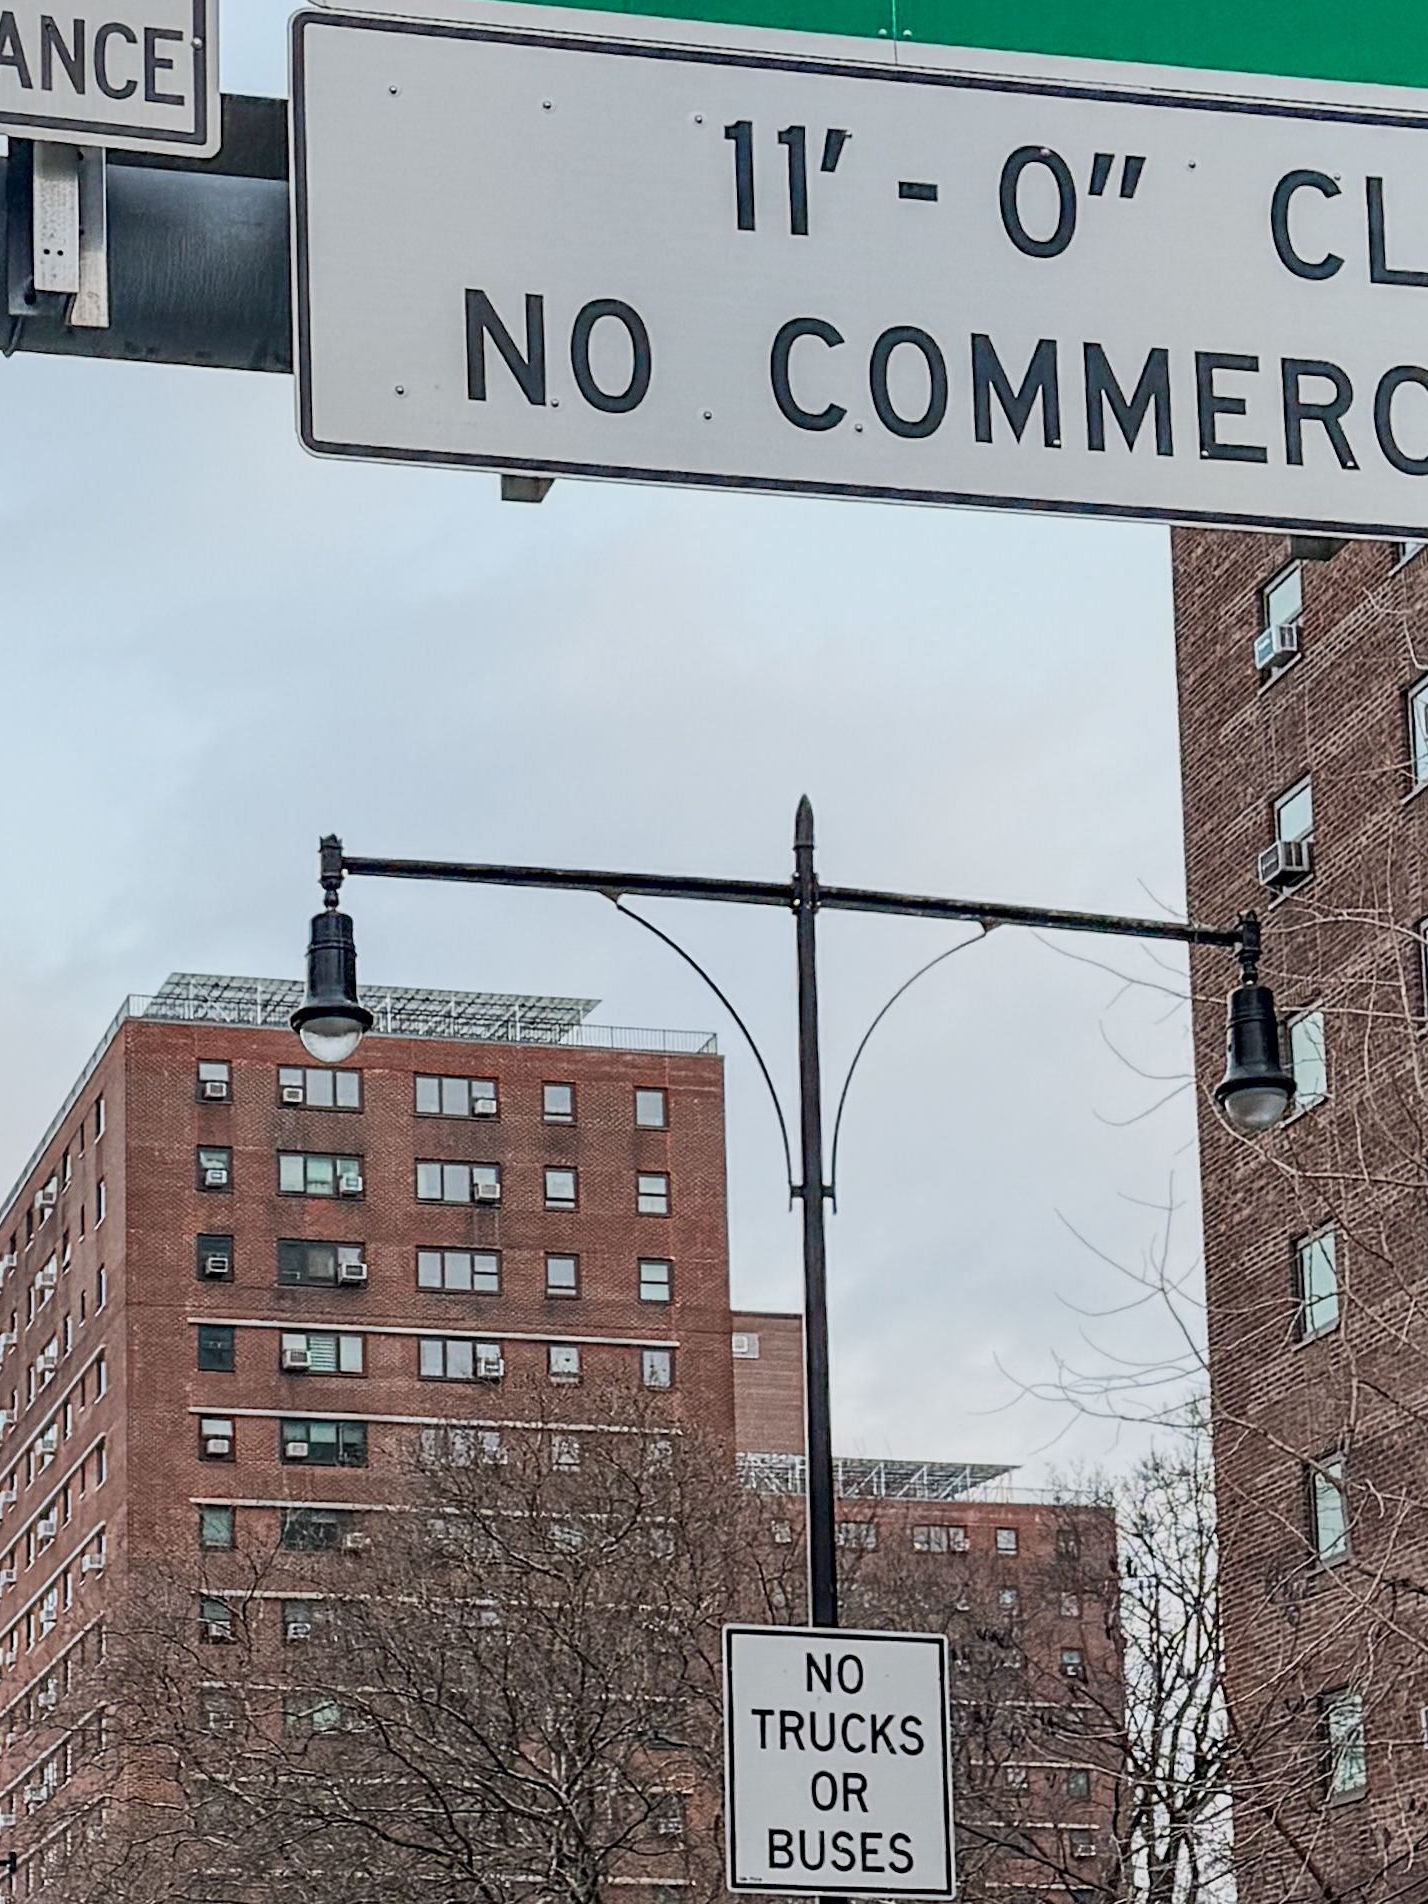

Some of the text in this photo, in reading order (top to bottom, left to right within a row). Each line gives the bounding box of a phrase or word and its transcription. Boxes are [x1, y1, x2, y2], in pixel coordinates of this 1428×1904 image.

[465, 288, 651, 413] NO
[807, 1653, 863, 1694] NO
[752, 1709, 924, 1755] TRUCKS
[812, 1771, 868, 1812] OR
[769, 1829, 913, 1873] BUSES
